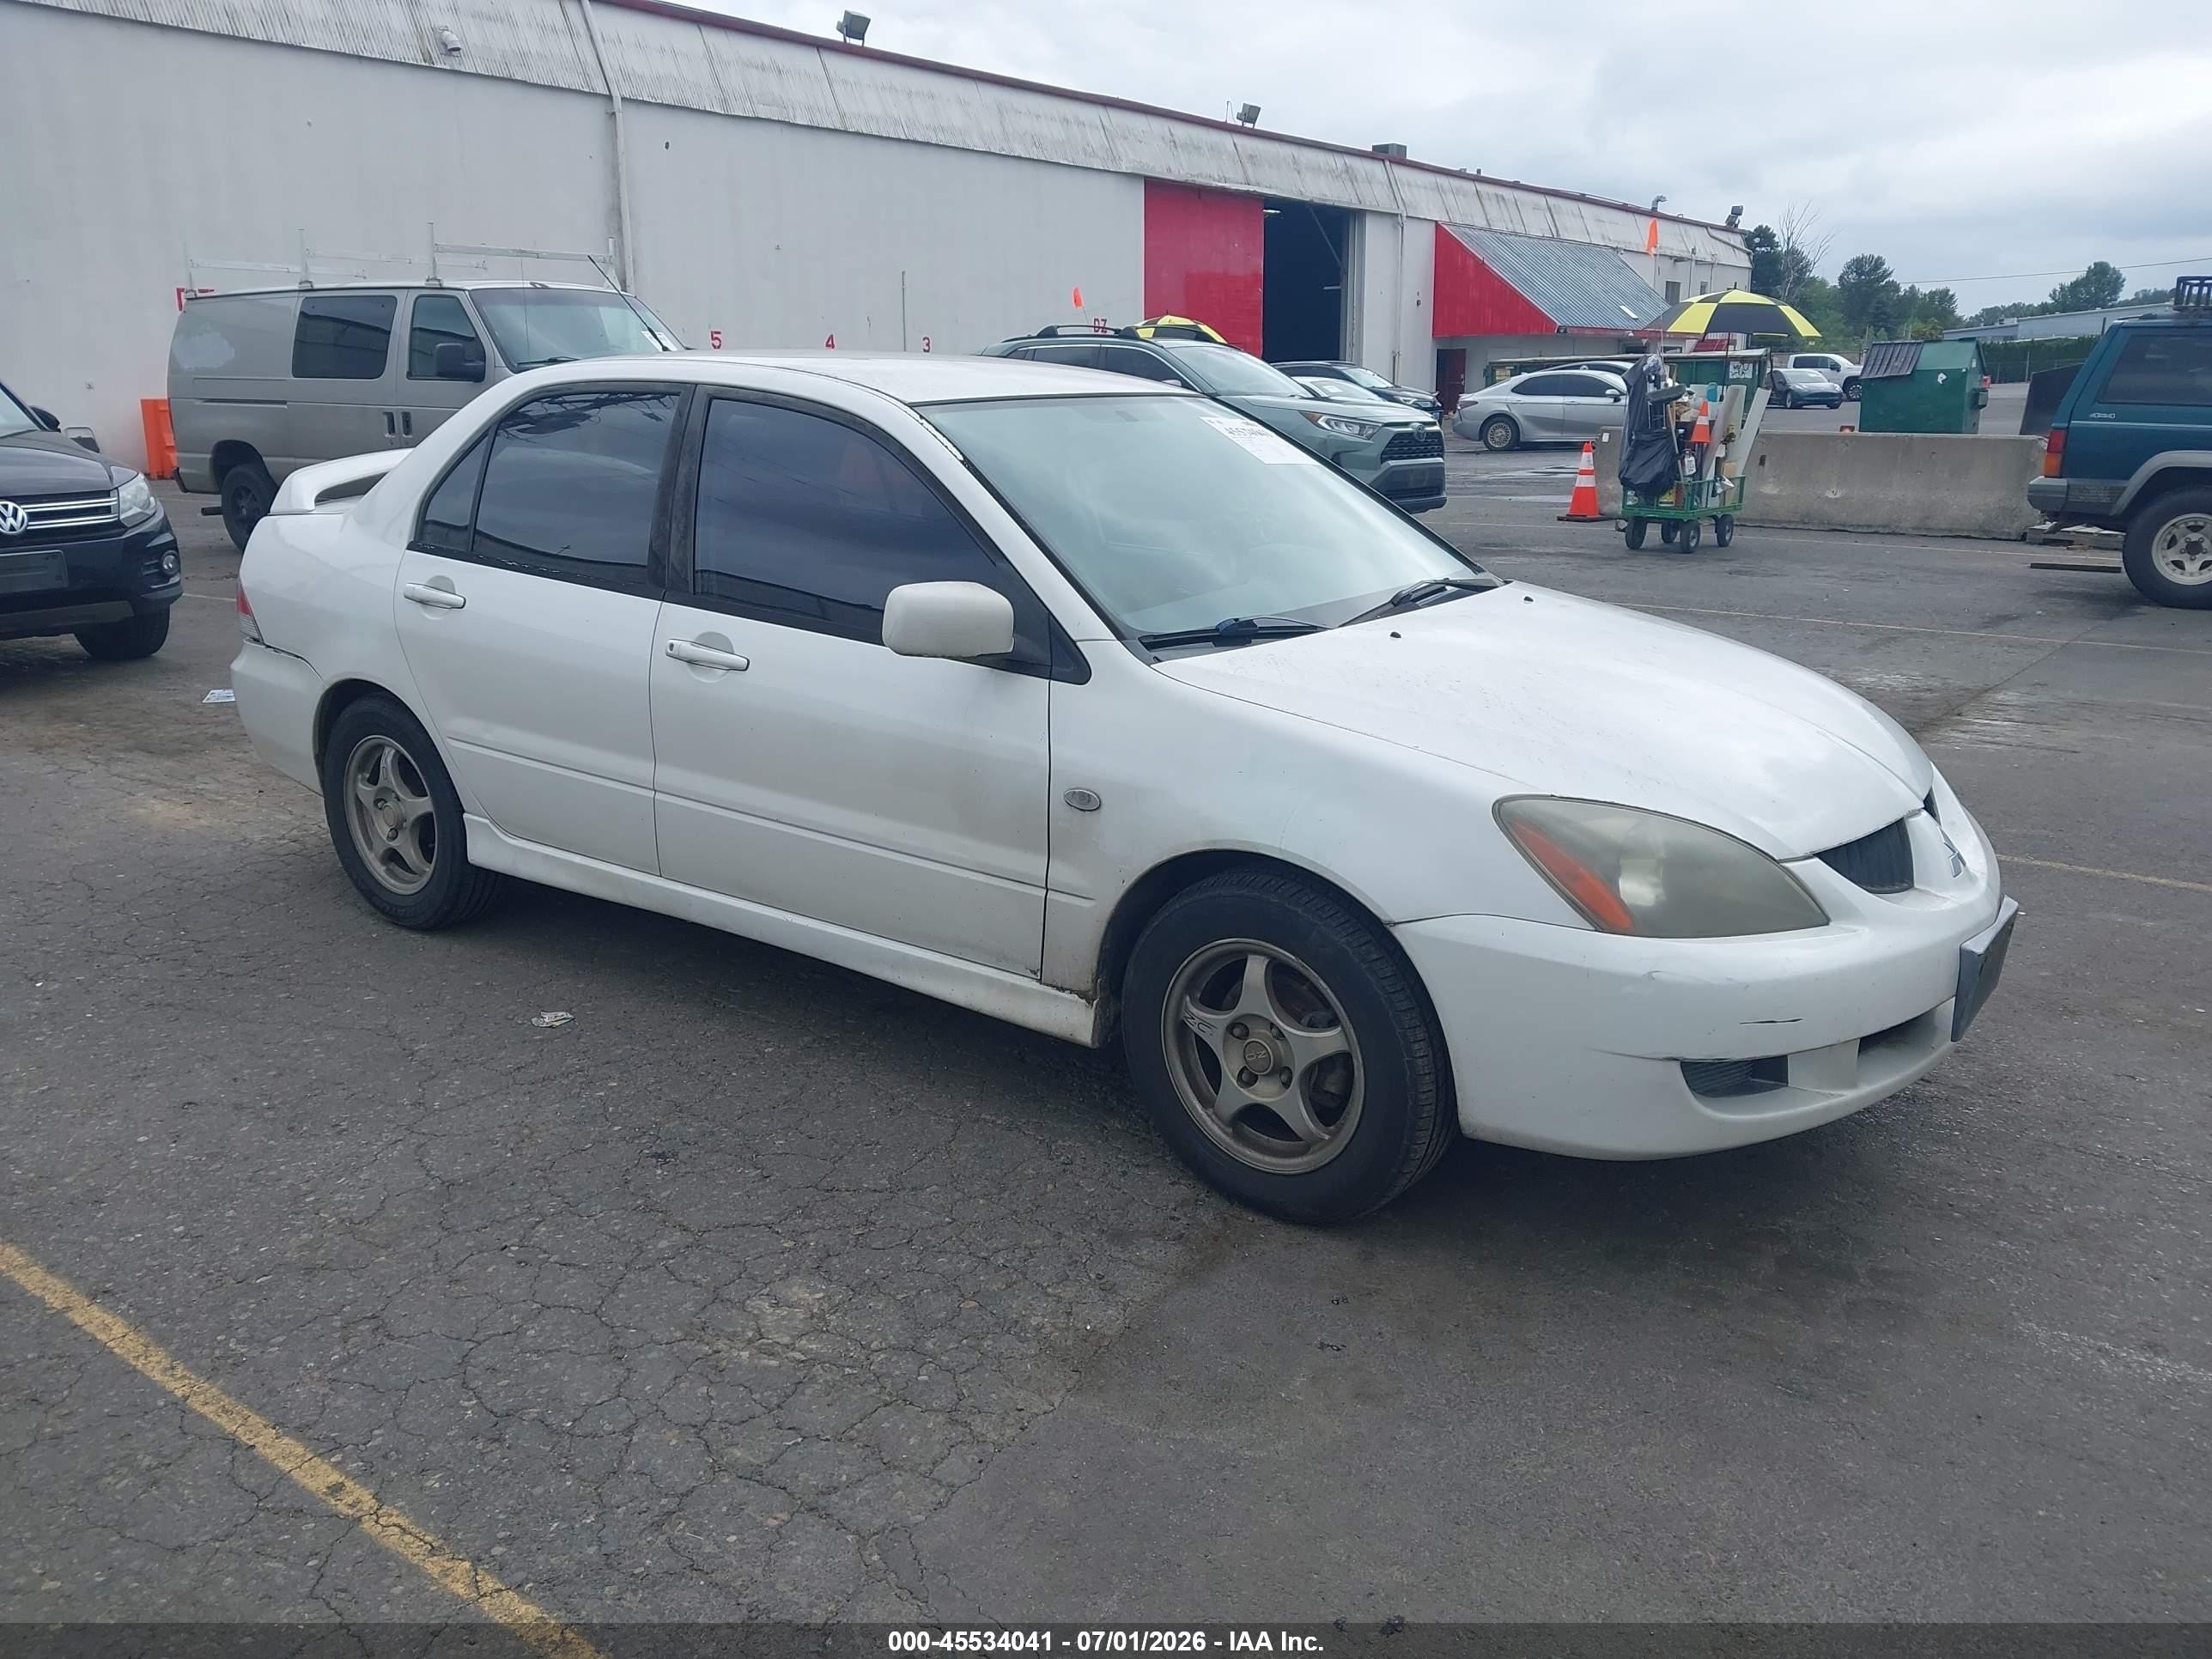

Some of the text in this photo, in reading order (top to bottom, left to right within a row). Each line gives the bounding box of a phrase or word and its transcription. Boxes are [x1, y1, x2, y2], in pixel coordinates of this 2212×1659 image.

[710, 331, 722, 349] 5
[825, 334, 836, 349] 4
[922, 336, 931, 353] 3
